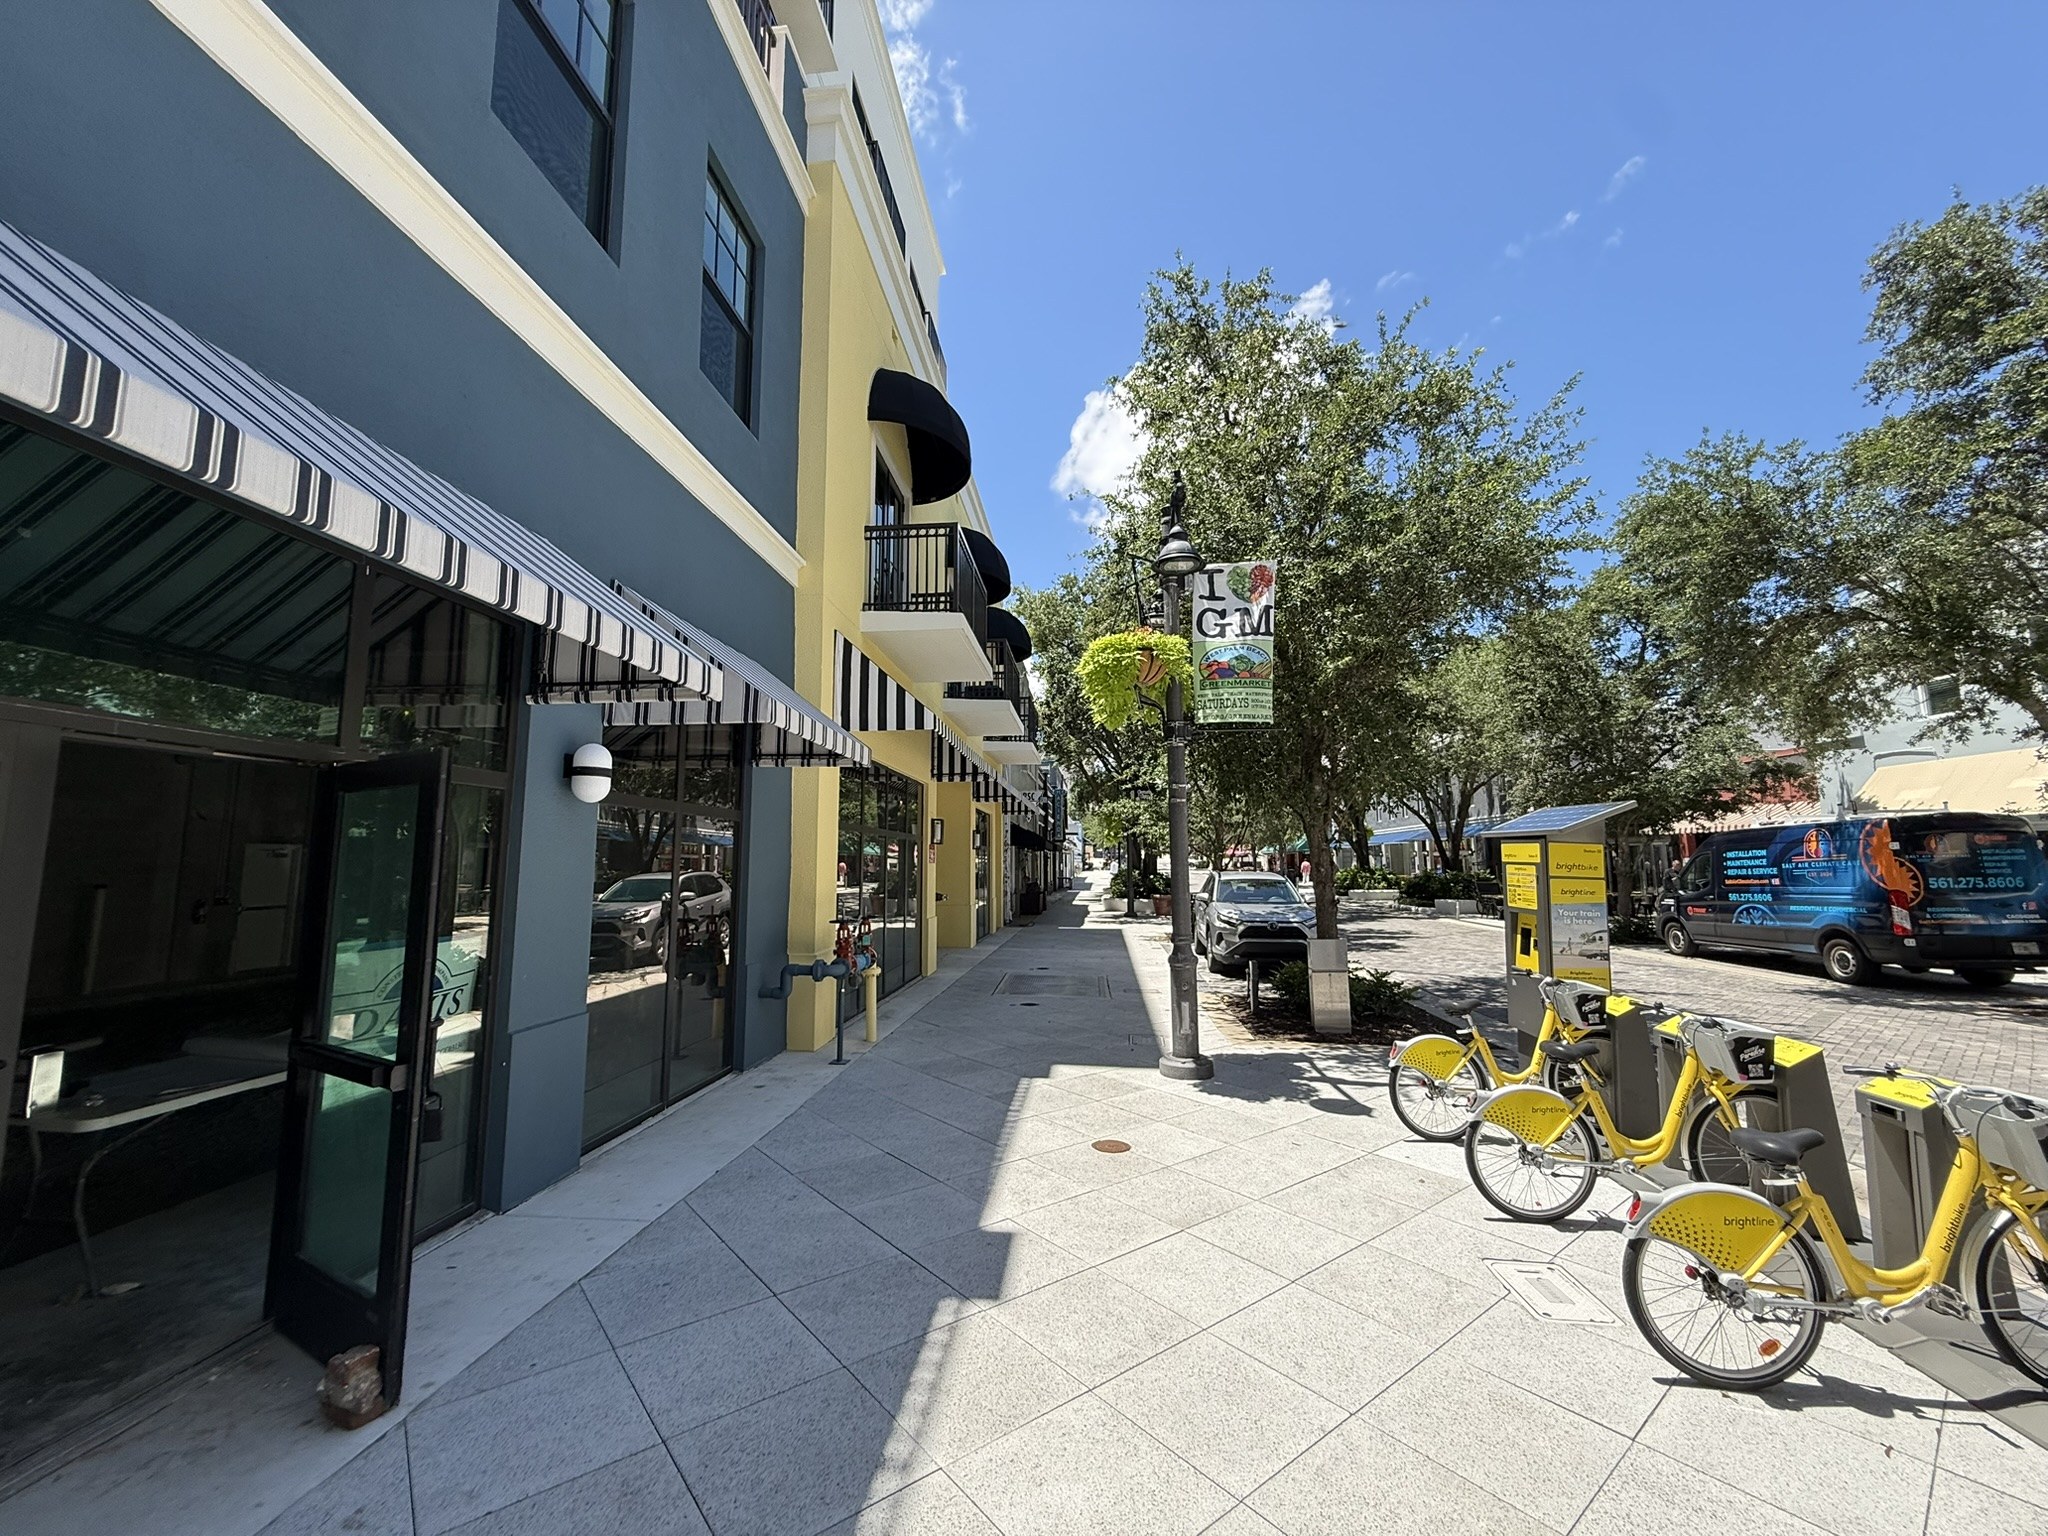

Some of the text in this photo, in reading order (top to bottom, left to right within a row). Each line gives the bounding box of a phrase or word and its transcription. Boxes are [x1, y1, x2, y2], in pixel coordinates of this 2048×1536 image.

[1198, 568, 1226, 601] I
[1196, 605, 1274, 639] GM
[1203, 649, 1222, 662] WEST
[1246, 645, 1269, 662] BEACH
[1197, 697, 1250, 710] SATURDAYS
[1727, 849, 1767, 858] INSTALLATION
[1556, 862, 1599, 872] brightbike
[1726, 858, 1767, 866] MAINTENANCE
[1752, 867, 1777, 875] SERVICE
[1928, 877, 2025, 889] 561.275.8606
[1560, 889, 1596, 897] brightline
[1728, 893, 1772, 902] 561.275.8606
[1558, 908, 1601, 917] Your train
[1828, 906, 1868, 914] COMMERCIAL
[344, 988, 463, 1041] DAIS
[1436, 1047, 1460, 1057] brightline
[1531, 1105, 1567, 1115] brightline
[1723, 1216, 1775, 1230] brightline
[1940, 1202, 1967, 1254] brightbike
